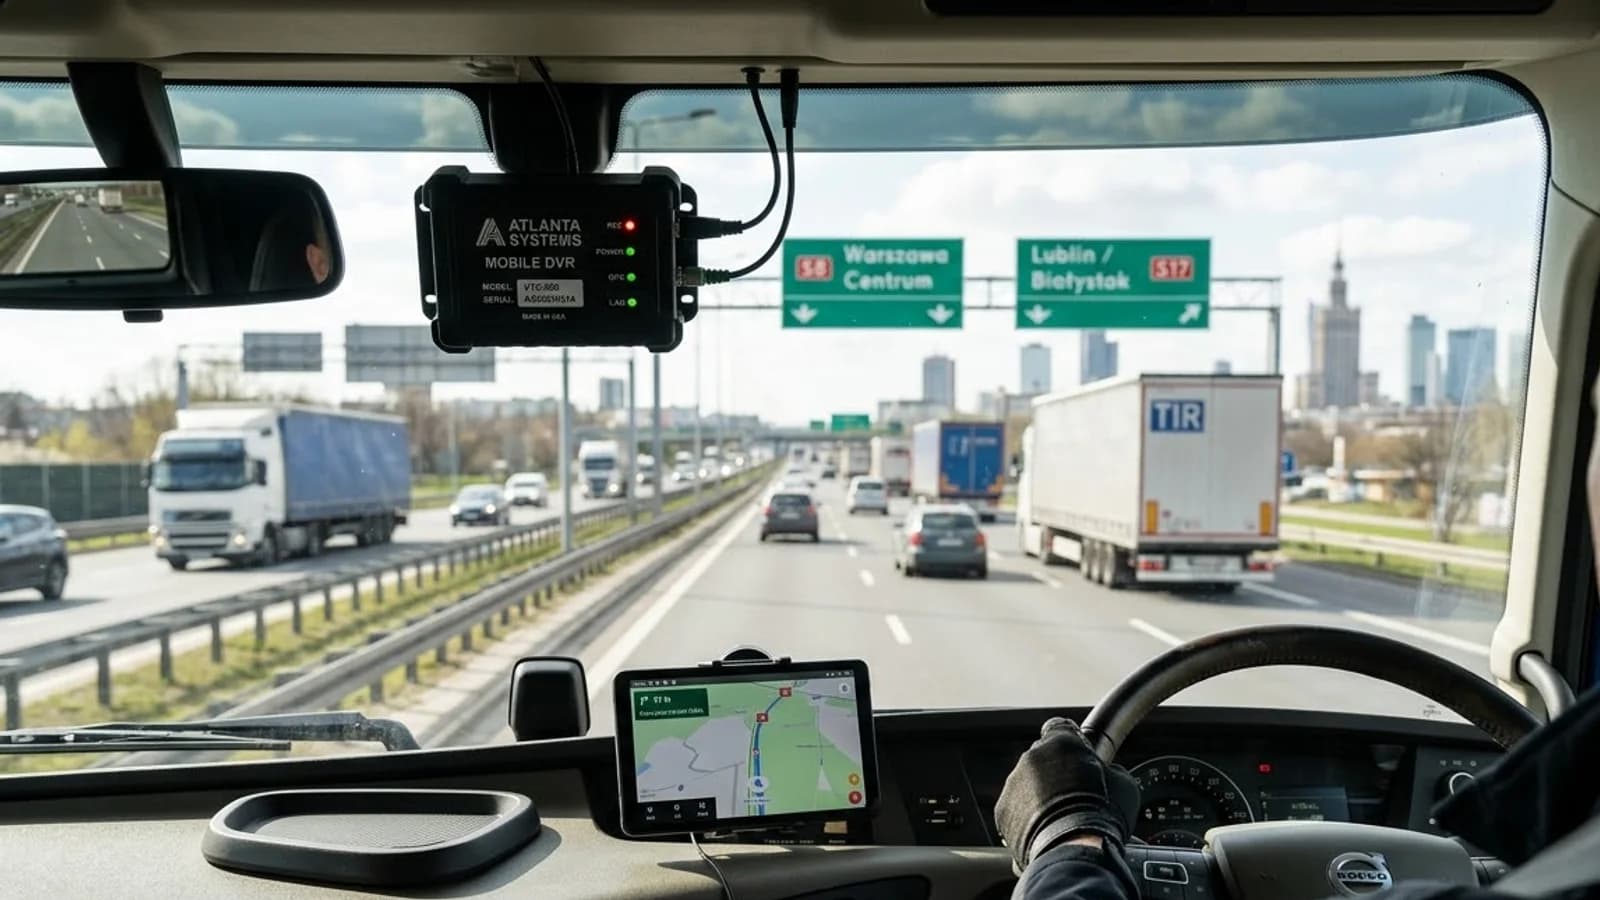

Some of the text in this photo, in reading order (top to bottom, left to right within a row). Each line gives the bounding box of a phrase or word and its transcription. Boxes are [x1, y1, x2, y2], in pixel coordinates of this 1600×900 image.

[509, 218, 581, 232] ATLANTA
[510, 233, 582, 247] SYSTEMS
[485, 256, 576, 269] MOBILE DVR
[843, 245, 949, 264] Warszawa
[1031, 245, 1096, 264] Lublin
[1156, 259, 1191, 278] S17
[843, 270, 934, 290] Centrum
[1154, 402, 1200, 429] TIR
